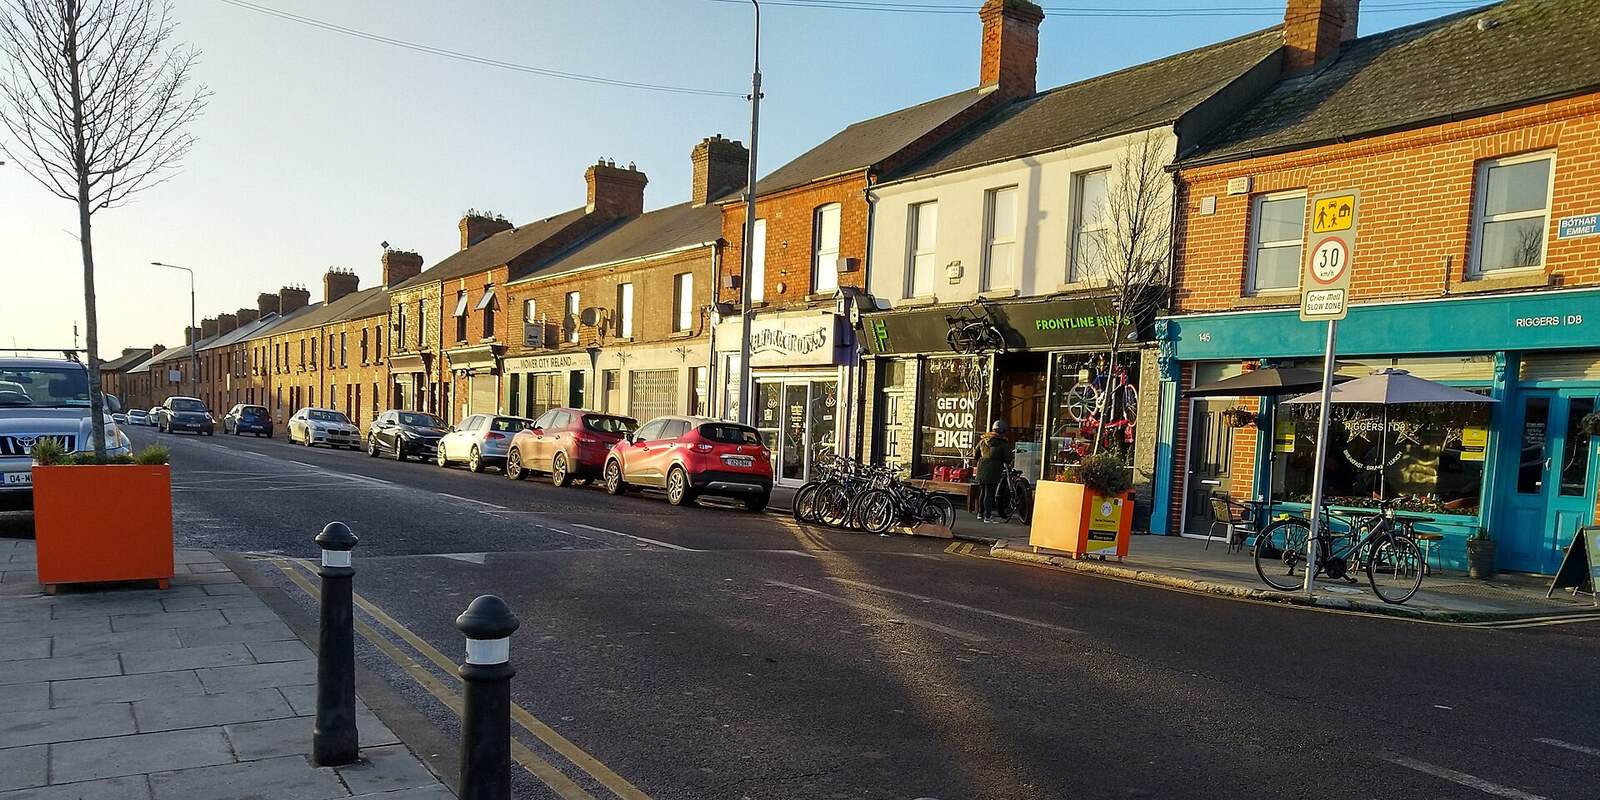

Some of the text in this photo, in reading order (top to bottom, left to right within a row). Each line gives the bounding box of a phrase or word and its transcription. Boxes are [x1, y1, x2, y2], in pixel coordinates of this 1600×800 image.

[1561, 216, 1597, 228] BÓTHAR
[1566, 225, 1596, 236] EMMET
[1319, 247, 1339, 268] 30
[1306, 302, 1342, 311] SLOW ZONE
[1035, 315, 1095, 330] FRONTLINE
[1516, 315, 1582, 328] RIGGERS D8
[550, 356, 572, 368] IRELAND
[937, 397, 975, 410] GET ON
[937, 412, 974, 429] YOUR
[1344, 422, 1384, 432] RIGGERS
[934, 430, 973, 449] BIKE!
